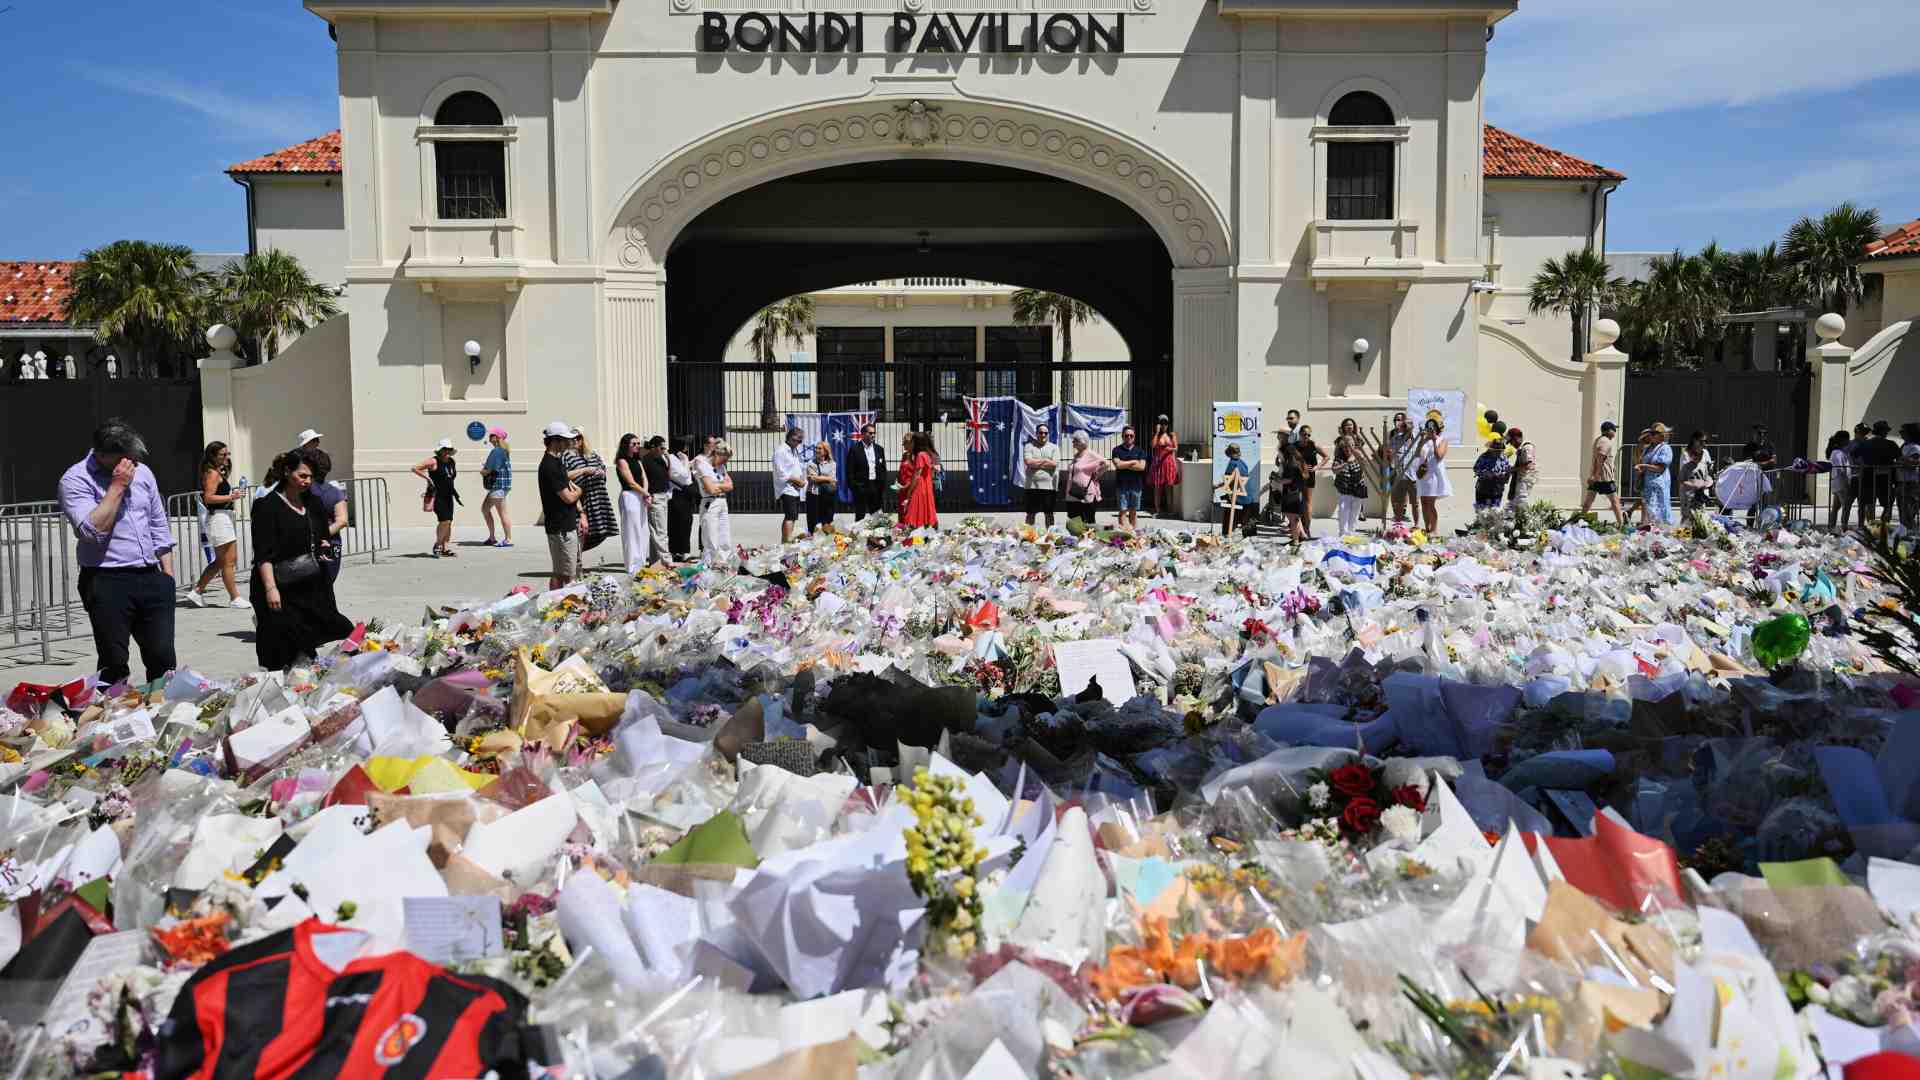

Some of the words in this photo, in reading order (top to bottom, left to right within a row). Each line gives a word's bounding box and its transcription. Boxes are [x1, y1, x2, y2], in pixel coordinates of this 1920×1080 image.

[703, 12, 863, 53] BONDI
[893, 12, 1124, 53] PAVILION
[1217, 415, 1257, 432] BNDI
